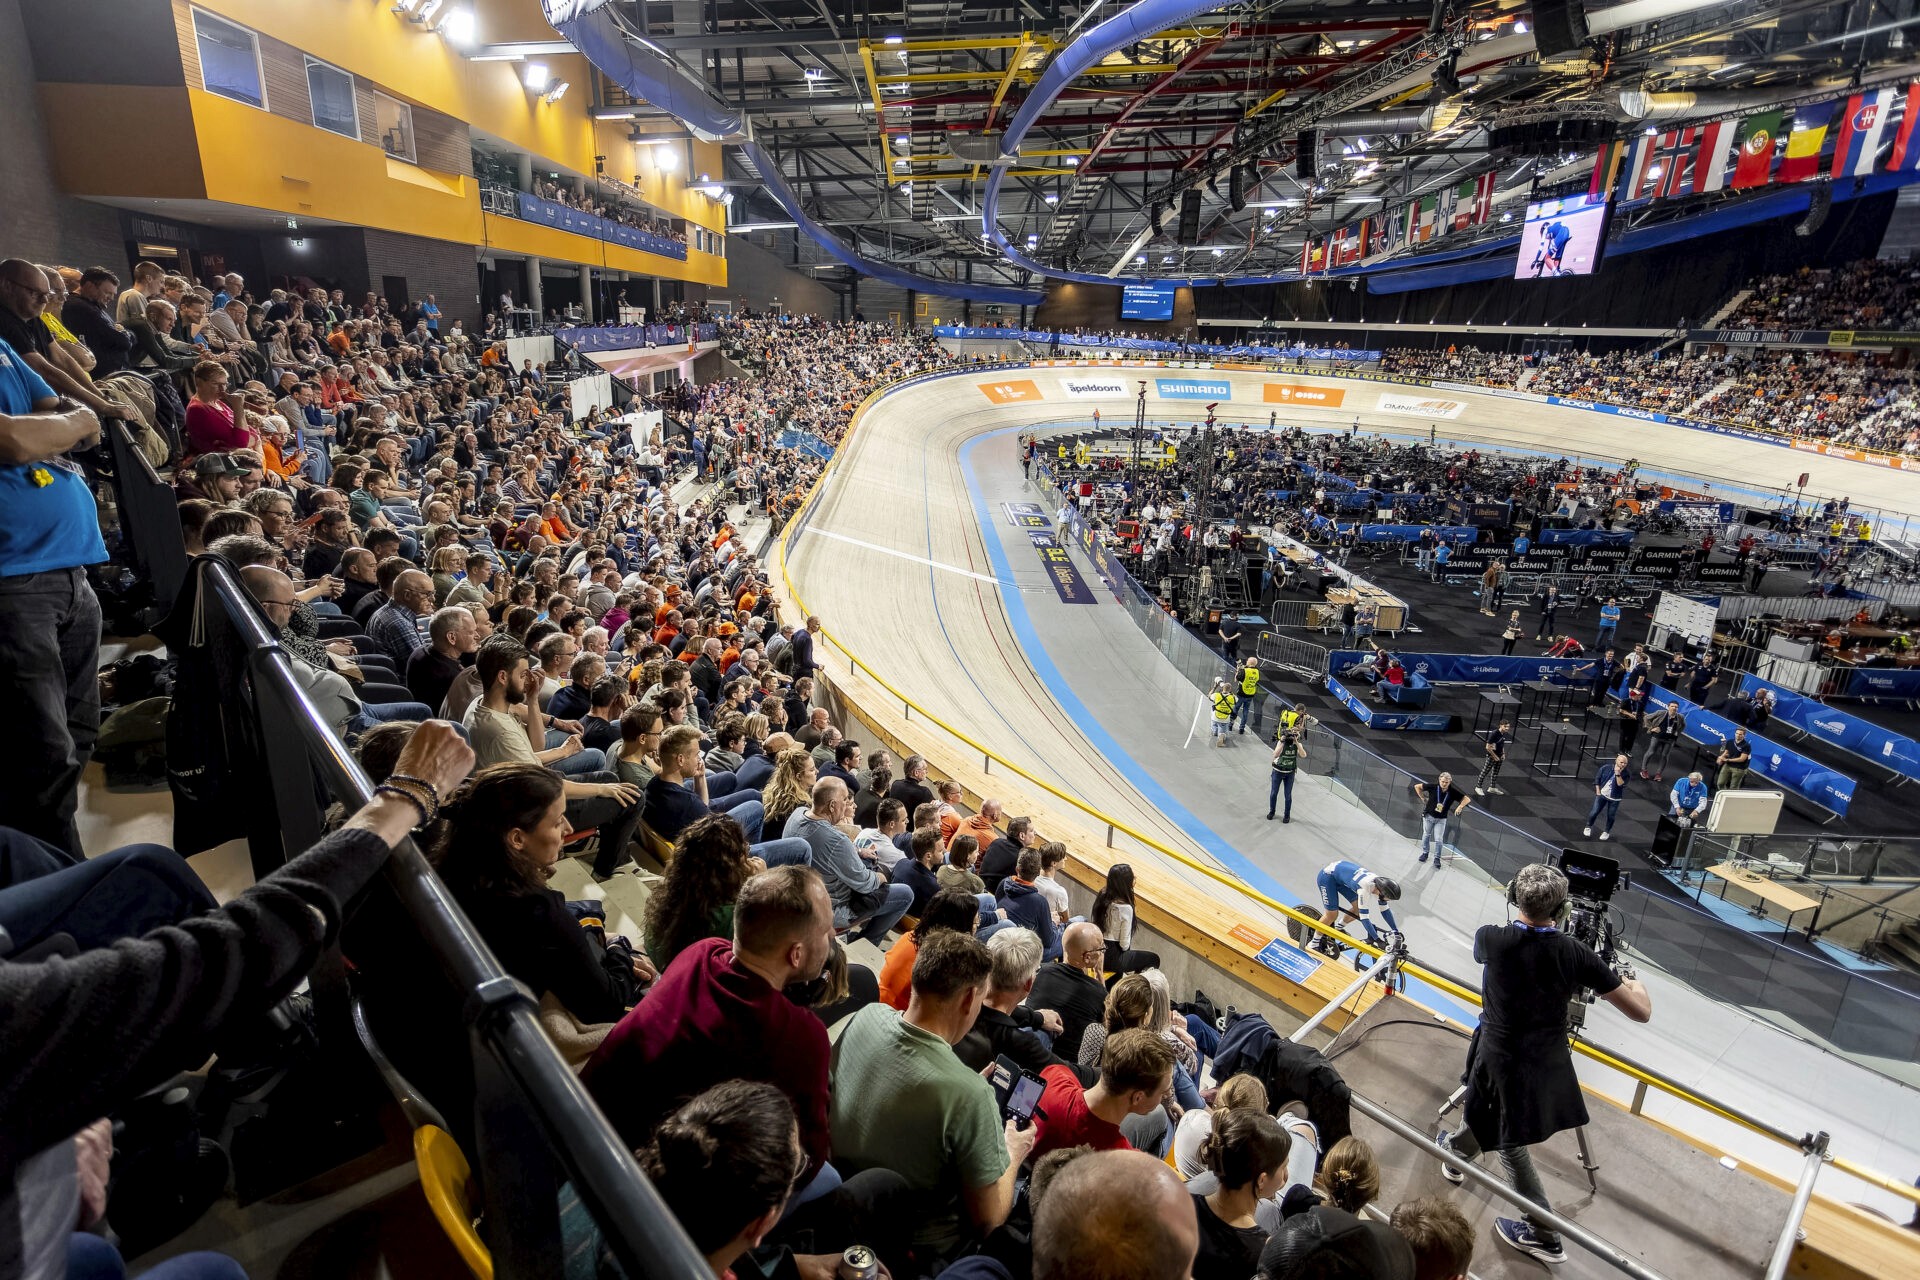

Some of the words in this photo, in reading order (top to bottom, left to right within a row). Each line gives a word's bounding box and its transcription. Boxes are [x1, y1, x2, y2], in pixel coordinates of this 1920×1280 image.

[1731, 332, 1752, 341] FOOD
[1753, 332, 1759, 341] &
[1762, 332, 1786, 342] DRINK
[1160, 384, 1227, 394] SHIMANO
[1558, 398, 1595, 410] KOGA
[1384, 403, 1450, 415] OMNISPORT
[1617, 408, 1654, 420] KOGA
[1796, 441, 1817, 452] TeamNL
[1864, 453, 1890, 466] TeamNL
[1473, 547, 1508, 555] GARMIN
[1530, 548, 1564, 556] GARMIN
[1590, 550, 1625, 558] GARMIN
[1646, 551, 1682, 559] GARMIN
[1571, 564, 1609, 572] GARMIN
[1635, 565, 1672, 573] GARMIN
[1701, 568, 1739, 576] GARMIN
